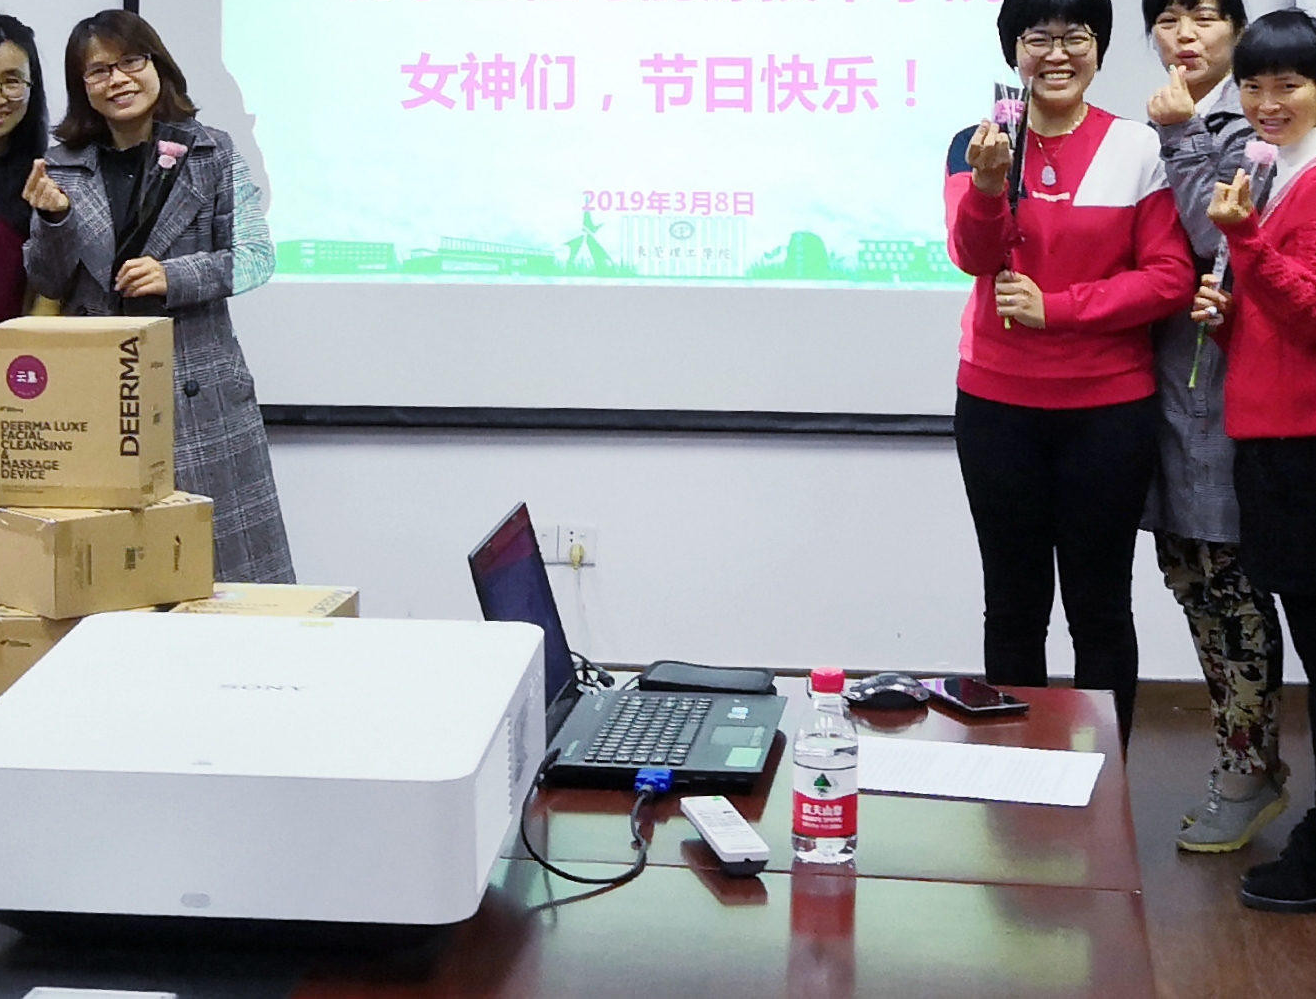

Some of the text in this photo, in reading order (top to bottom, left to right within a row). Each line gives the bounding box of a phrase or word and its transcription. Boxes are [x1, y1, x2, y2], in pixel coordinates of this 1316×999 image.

[401, 52, 918, 114] 女神们，节日快乐！
[582, 190, 755, 217] 2019年3月8日
[119, 335, 140, 457] DEERMA
[1, 421, 88, 432] DEERMA LUXE
[1, 431, 44, 441] FACIAL
[1, 440, 73, 451] CLEANSING
[1, 460, 60, 470] MASSAGE
[1, 470, 46, 480] DEVICE
